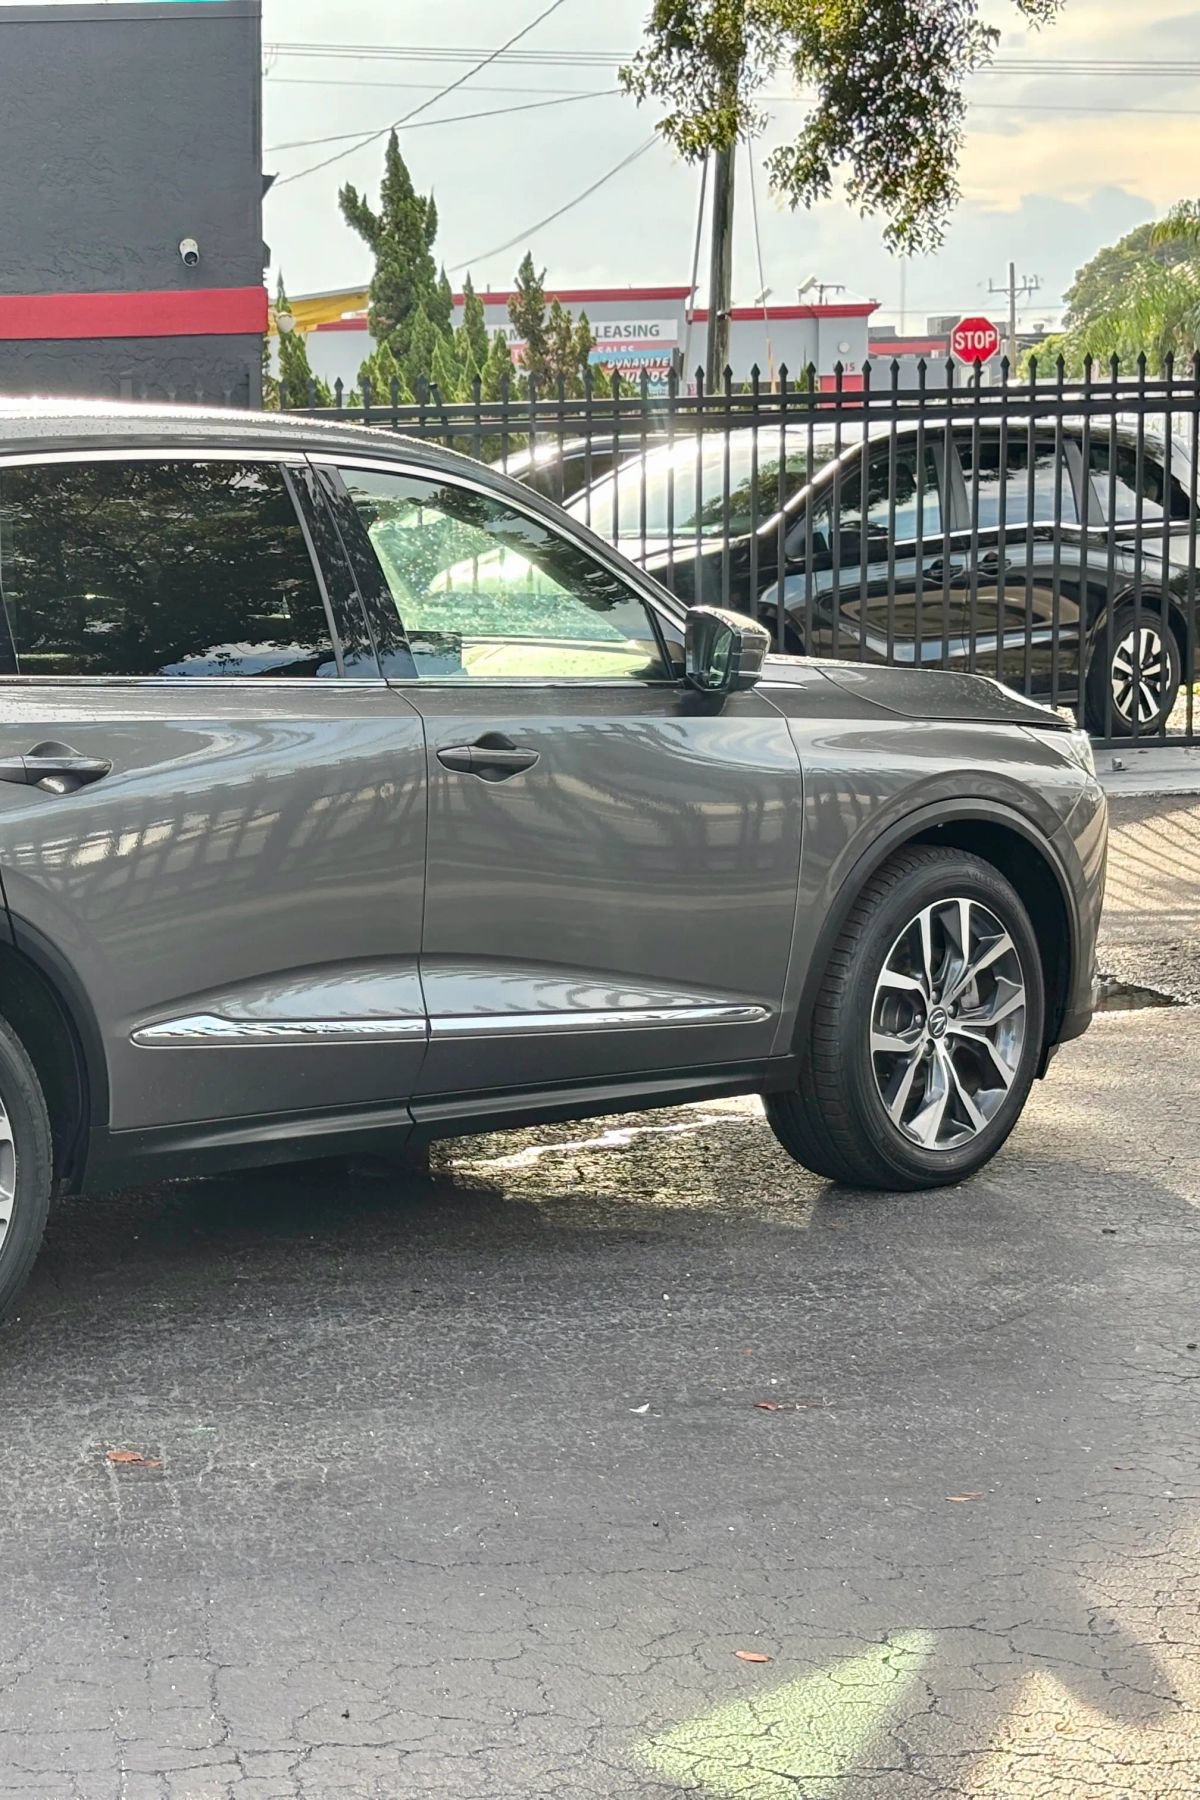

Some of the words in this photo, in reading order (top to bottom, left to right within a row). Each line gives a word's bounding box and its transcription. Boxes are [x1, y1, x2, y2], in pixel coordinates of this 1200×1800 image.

[595, 324, 660, 338] LEASING
[955, 330, 995, 350] STOP
[607, 357, 669, 369] DYNAMITE
